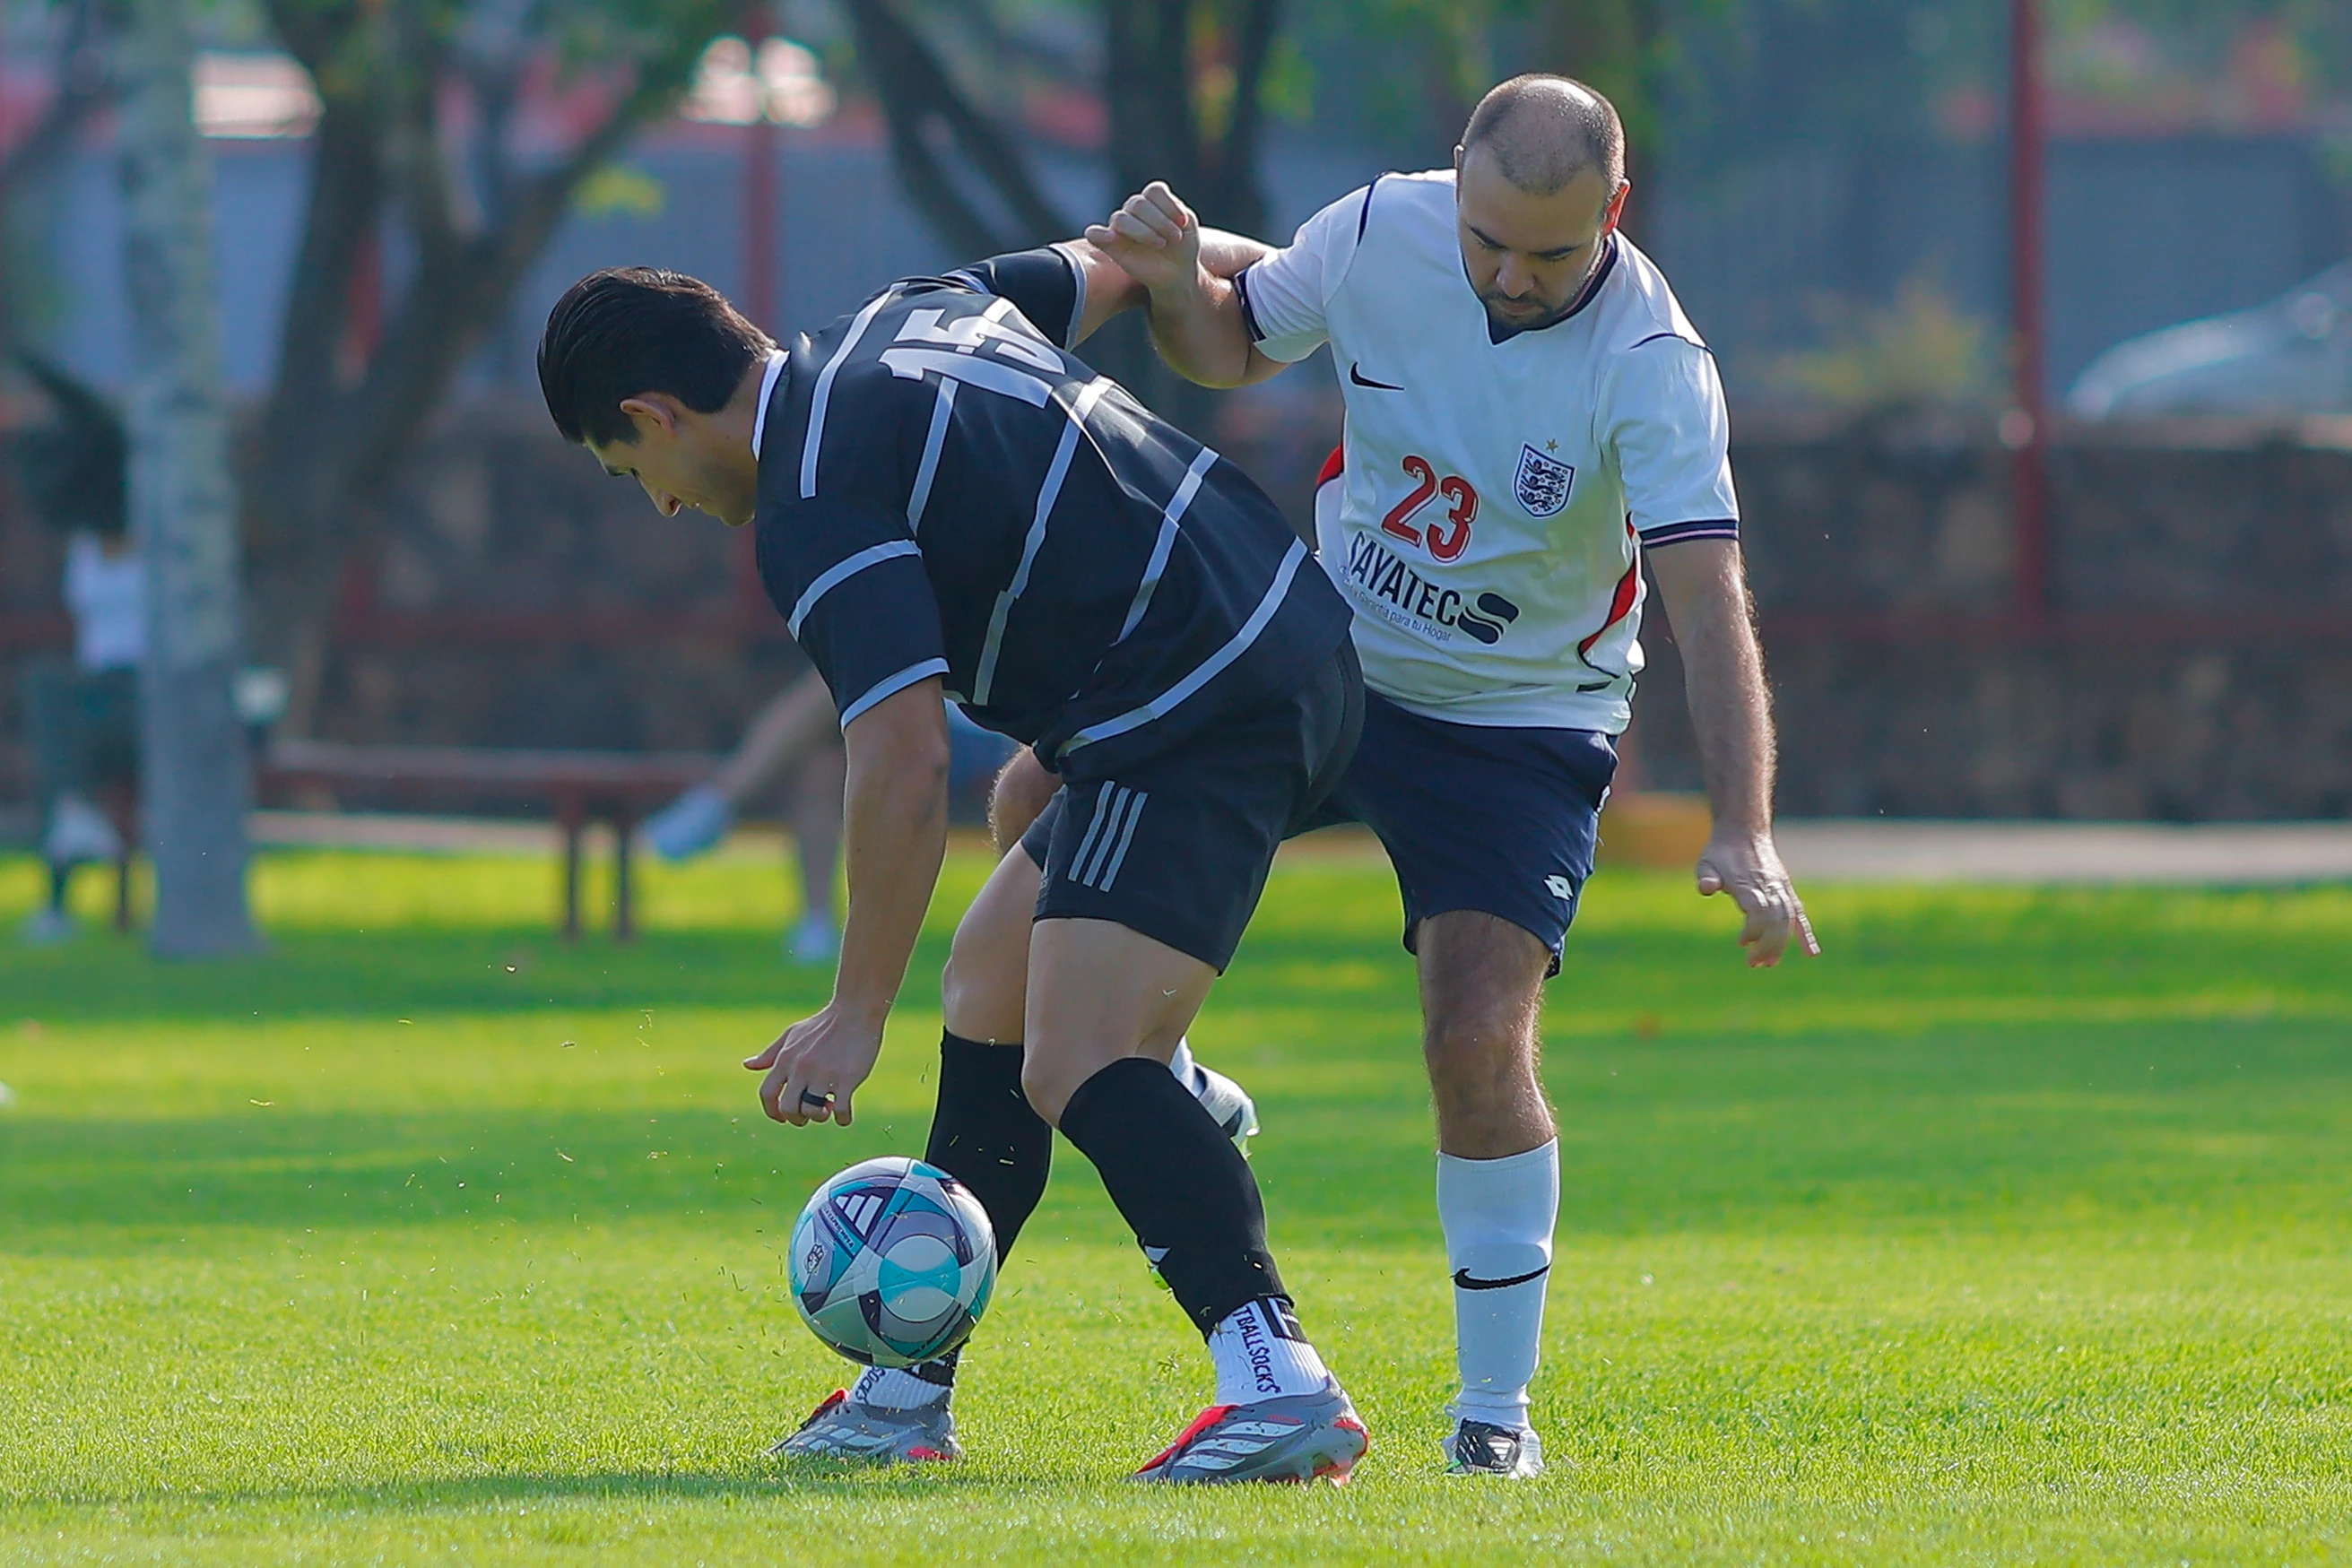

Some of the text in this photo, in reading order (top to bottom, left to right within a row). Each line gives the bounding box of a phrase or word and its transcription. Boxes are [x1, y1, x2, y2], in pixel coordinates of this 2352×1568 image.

[878, 308, 1066, 409] 15
[1381, 455, 1479, 563] 23
[1389, 611, 1411, 628] para
[1411, 619, 1422, 631] tu
[1422, 622, 1452, 642] Hogar
